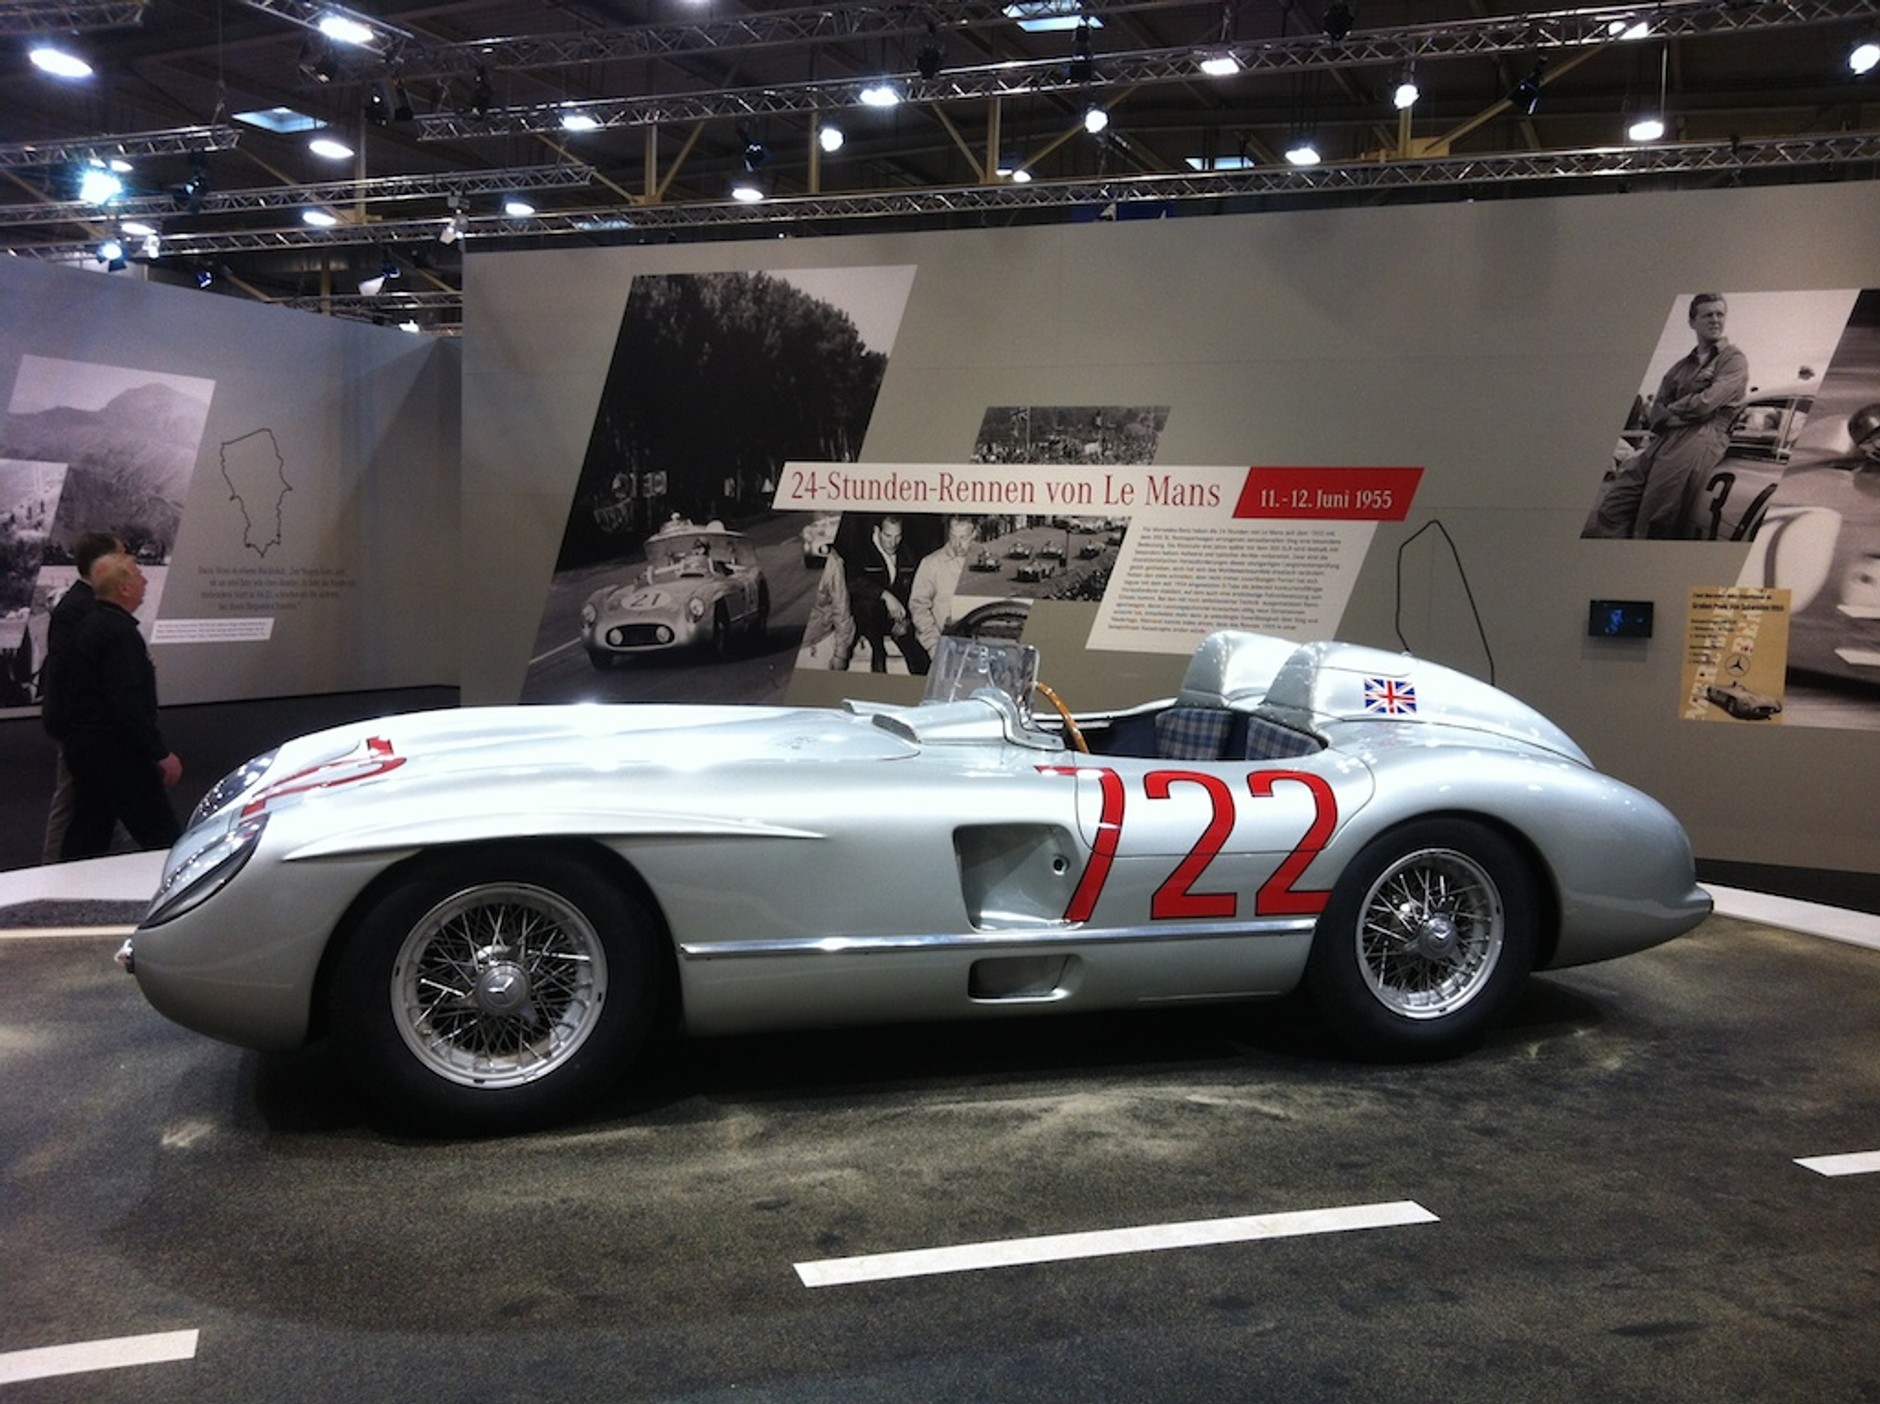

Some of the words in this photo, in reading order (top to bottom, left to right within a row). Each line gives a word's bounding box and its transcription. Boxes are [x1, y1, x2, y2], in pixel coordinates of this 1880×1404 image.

[790, 470, 1036, 505] 24-Stunden-Rennen
[1046, 482, 1093, 506] von
[1103, 474, 1134, 506] Le
[1143, 475, 1221, 509] Mans
[1316, 488, 1350, 510] Juni
[1355, 489, 1393, 509] 1955
[630, 593, 661, 607] 21
[1035, 765, 1337, 922] 722
